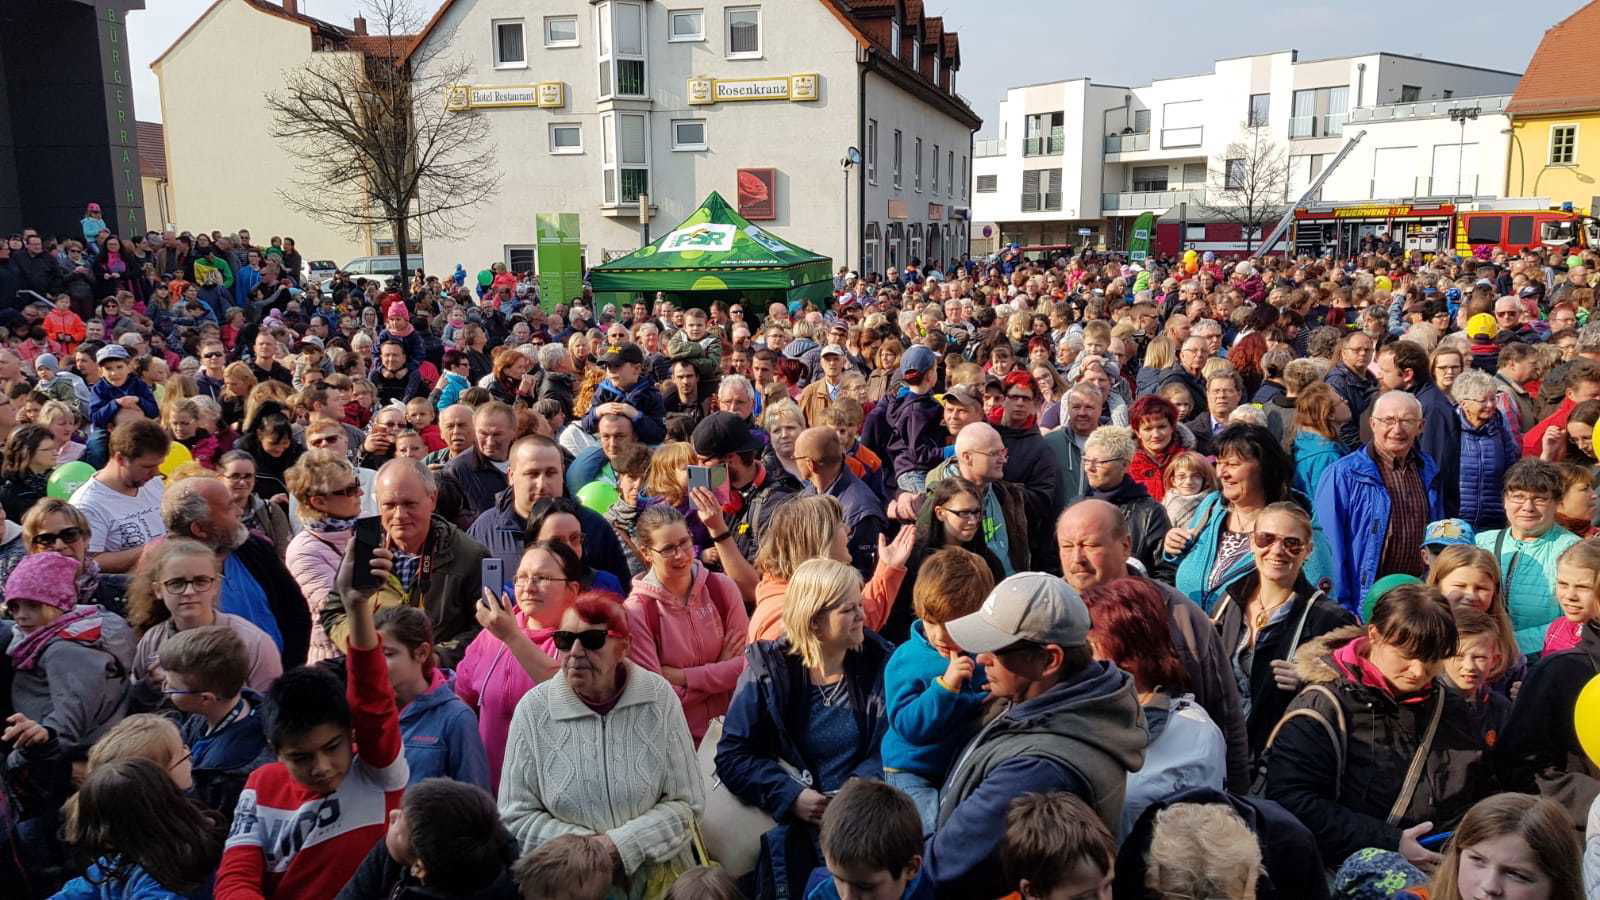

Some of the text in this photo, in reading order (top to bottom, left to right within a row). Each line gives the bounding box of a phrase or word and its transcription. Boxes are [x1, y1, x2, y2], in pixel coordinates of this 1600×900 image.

[473, 90, 492, 101] Hotel
[495, 90, 534, 101] Restaurant
[718, 83, 787, 96] Rosenkranz
[1335, 207, 1389, 217] FEUERWEHR
[423, 554, 431, 573] EOS
